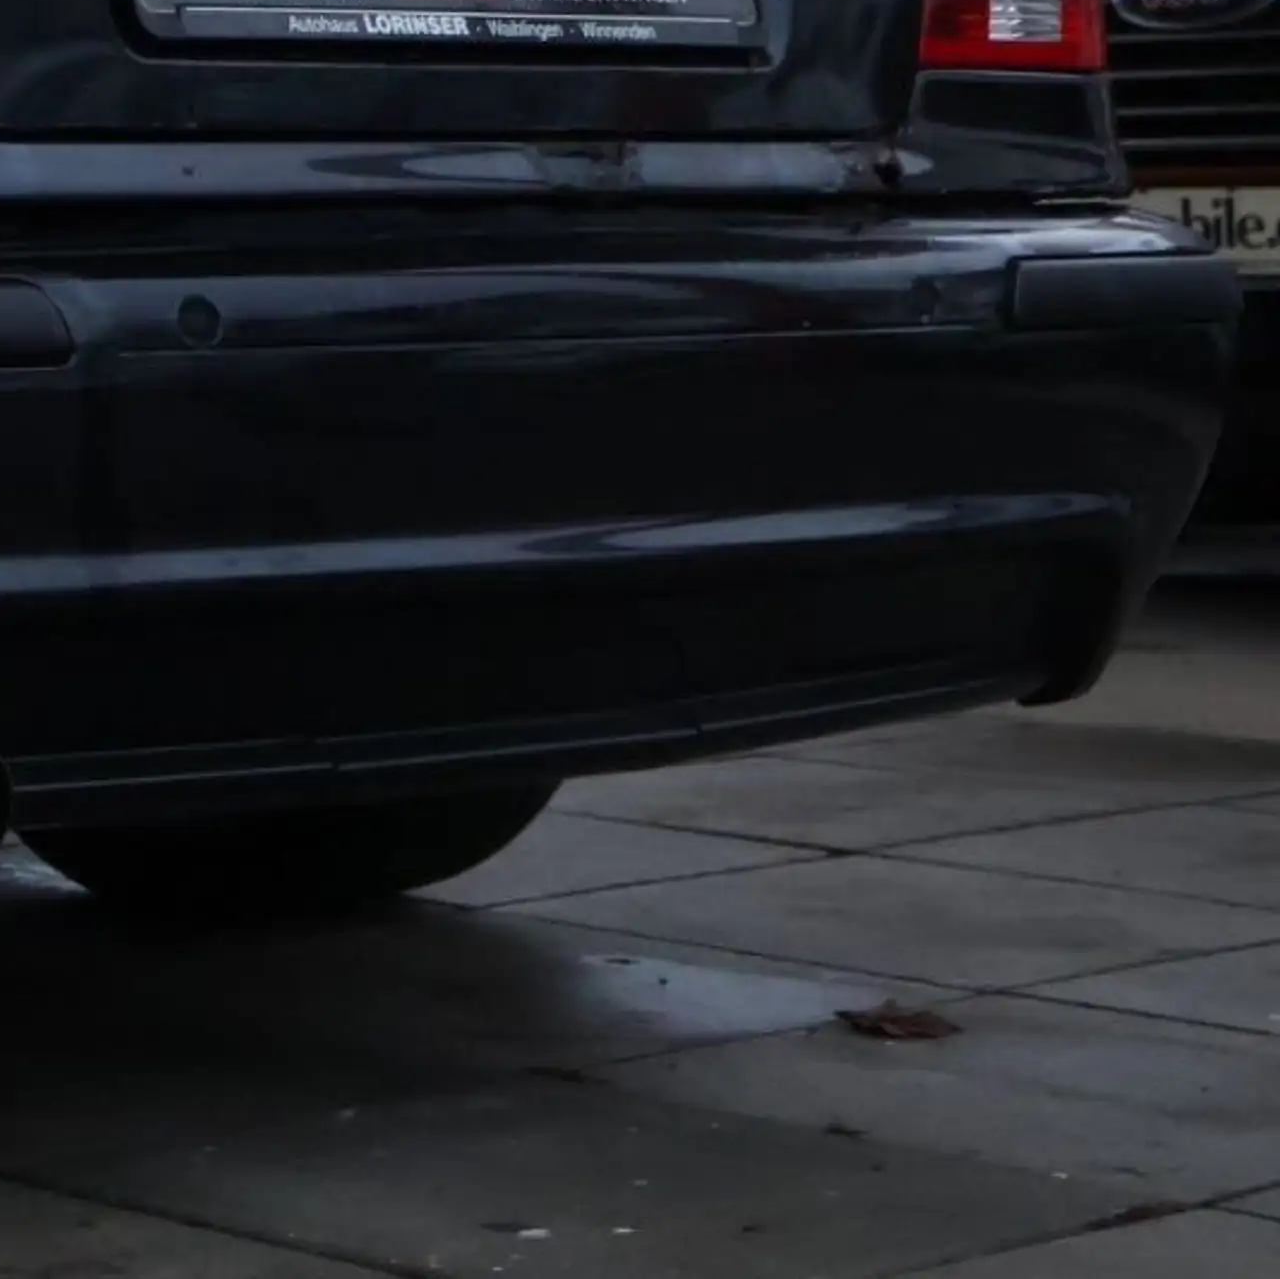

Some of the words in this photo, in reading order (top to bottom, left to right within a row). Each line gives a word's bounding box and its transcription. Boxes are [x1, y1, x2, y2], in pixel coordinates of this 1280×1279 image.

[289, 15, 359, 33] Autohaus
[362, 14, 471, 36] LORINSER
[1181, 196, 1280, 250] bile.
